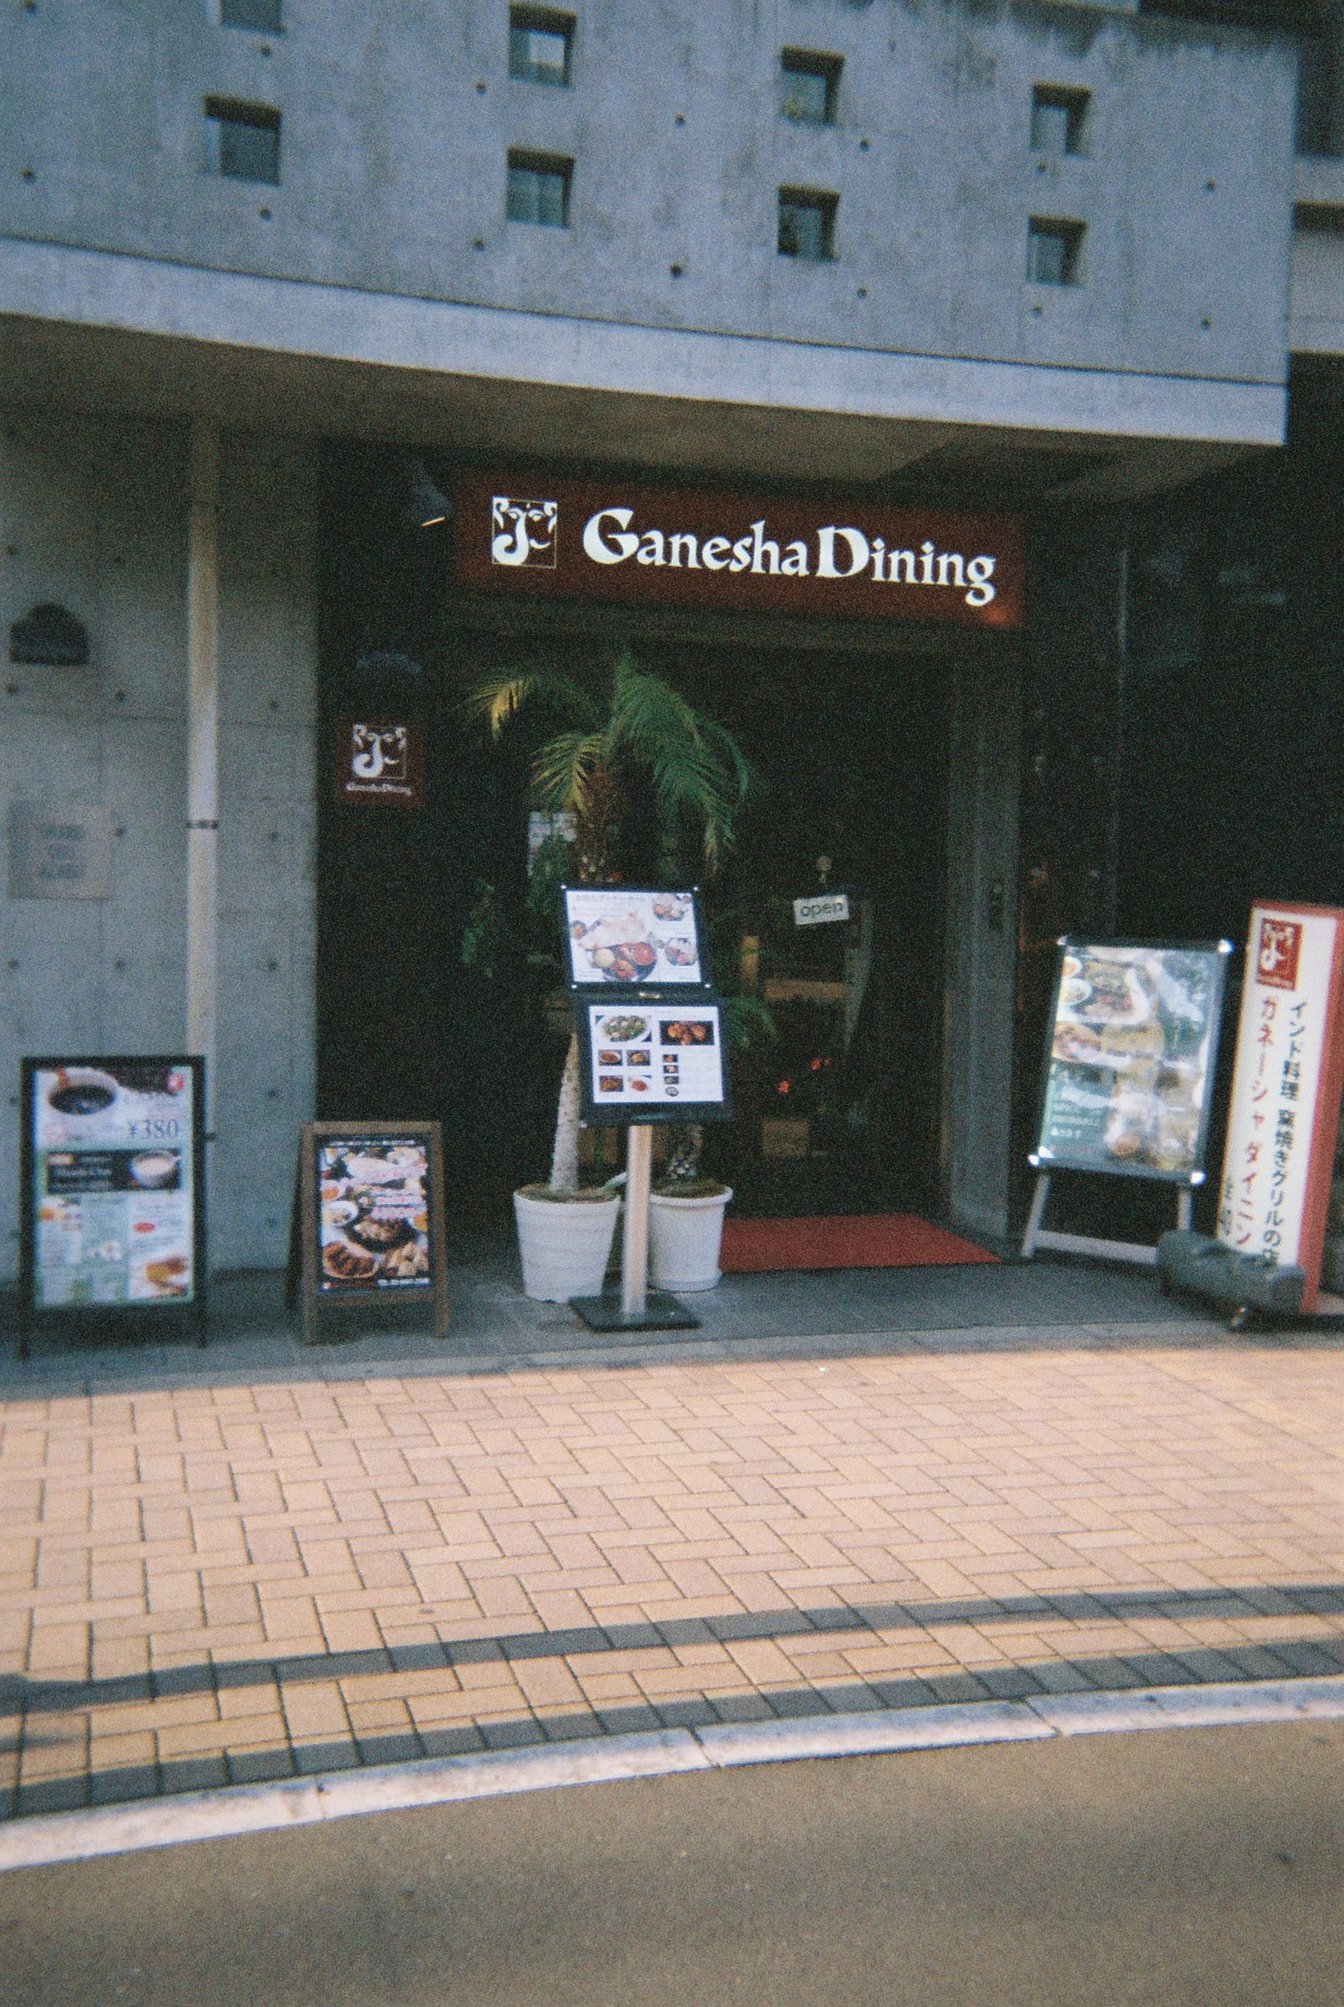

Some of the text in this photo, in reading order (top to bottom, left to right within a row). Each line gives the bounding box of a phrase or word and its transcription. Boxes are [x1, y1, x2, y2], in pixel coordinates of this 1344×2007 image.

[582, 506, 997, 607] Ganesha Dining
[801, 902, 844, 919] open
